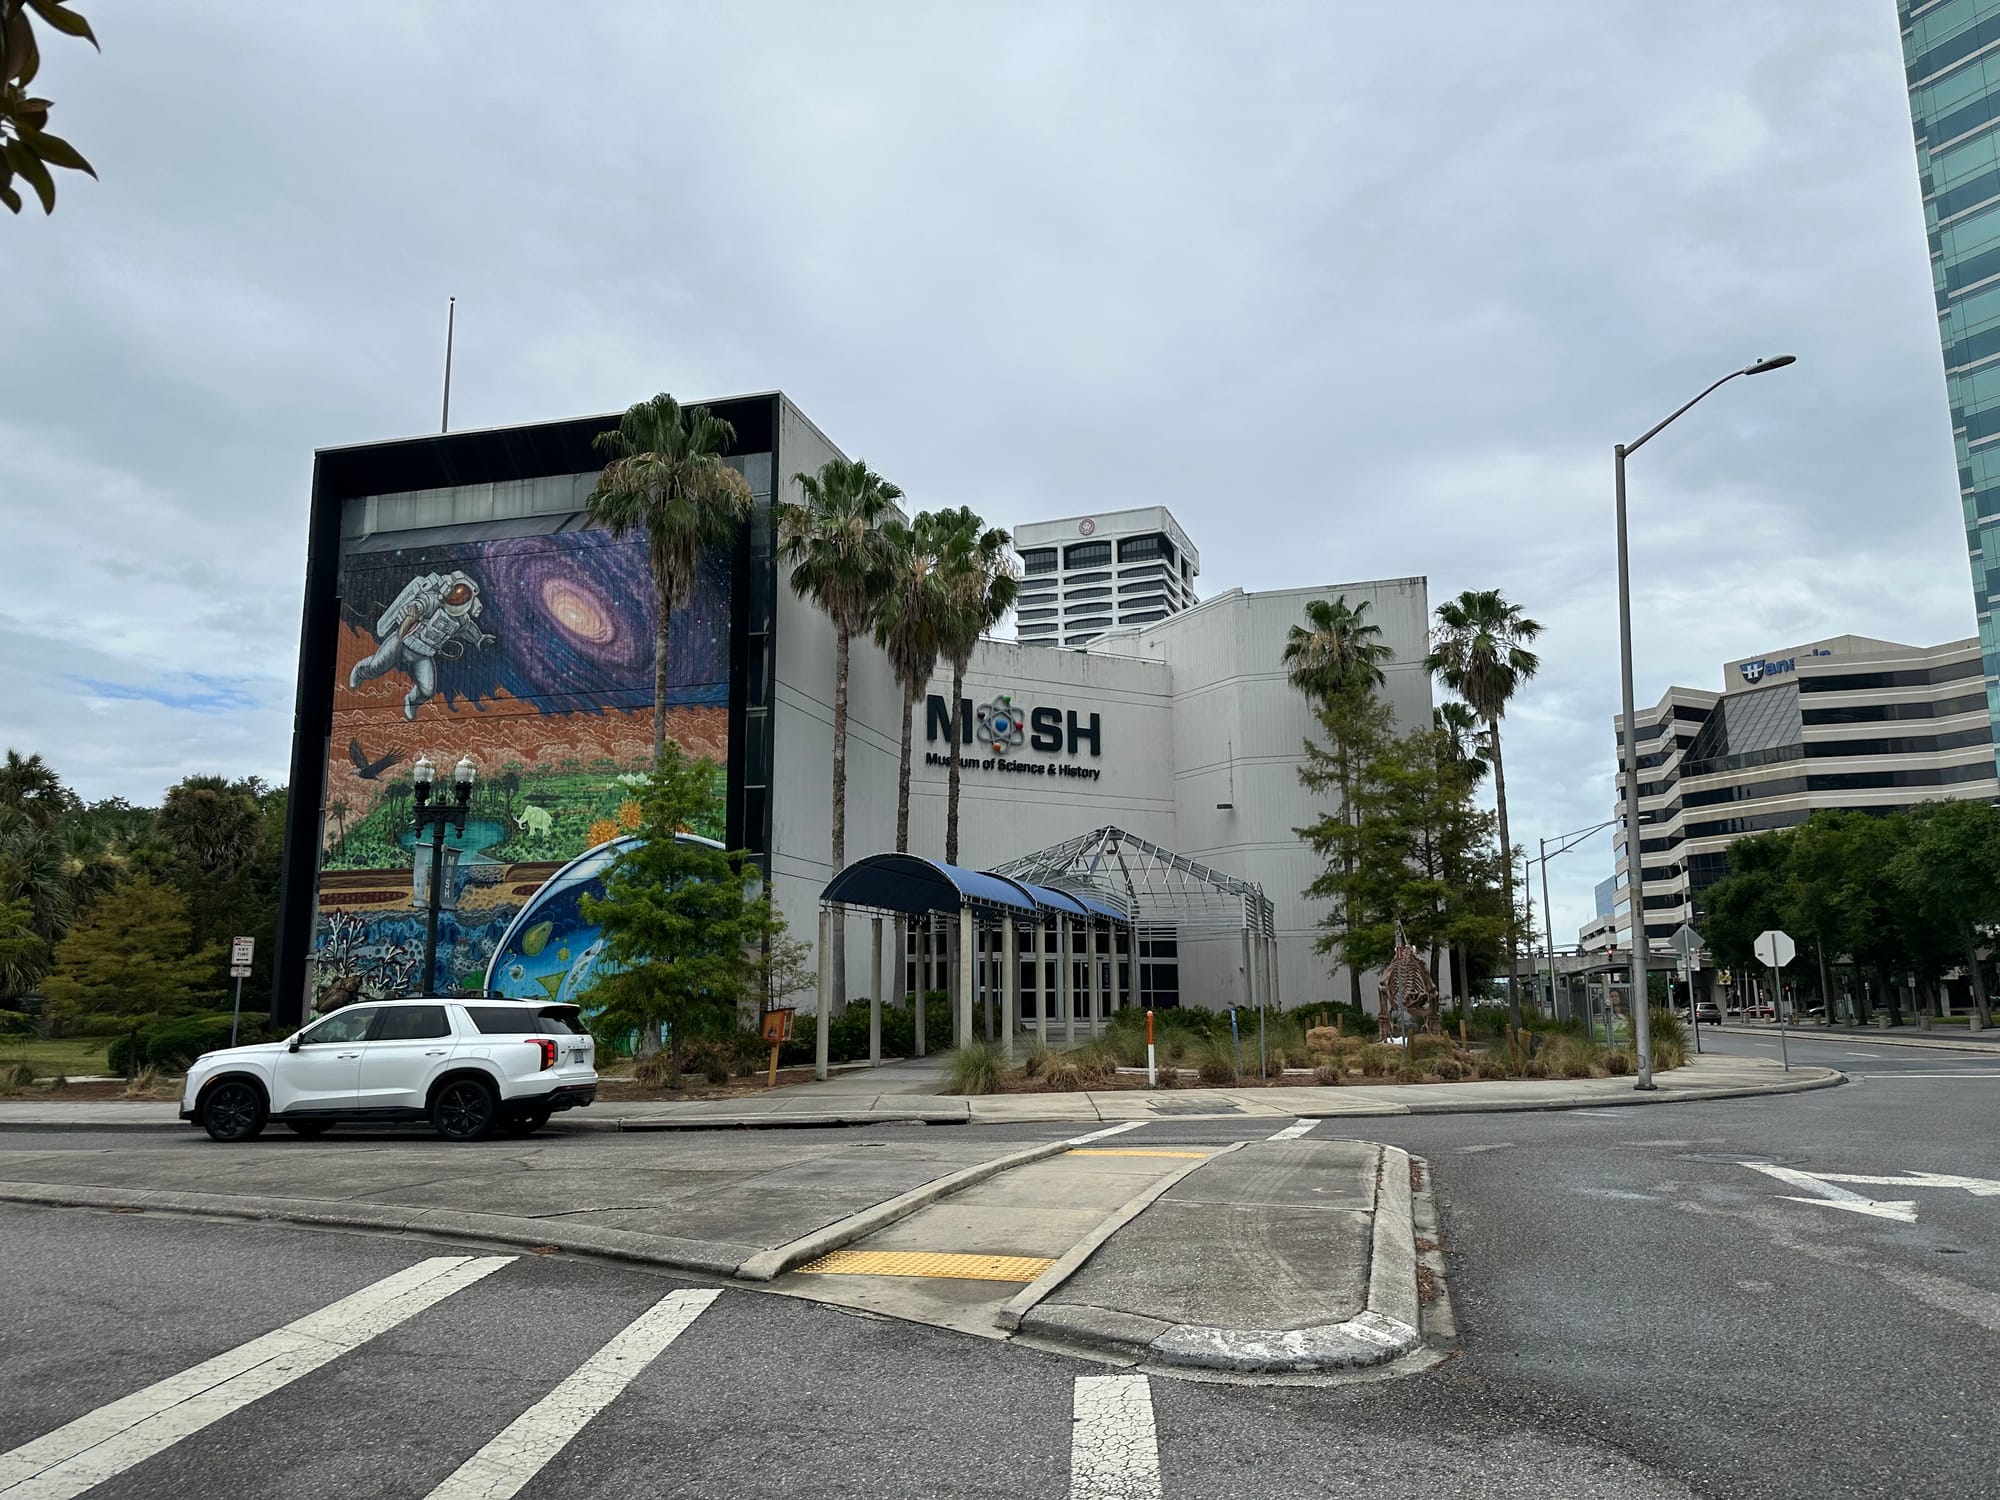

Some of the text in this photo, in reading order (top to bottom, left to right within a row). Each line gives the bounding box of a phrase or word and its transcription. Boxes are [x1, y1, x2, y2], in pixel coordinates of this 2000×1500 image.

[926, 752, 1101, 780] Musum of Science & History
